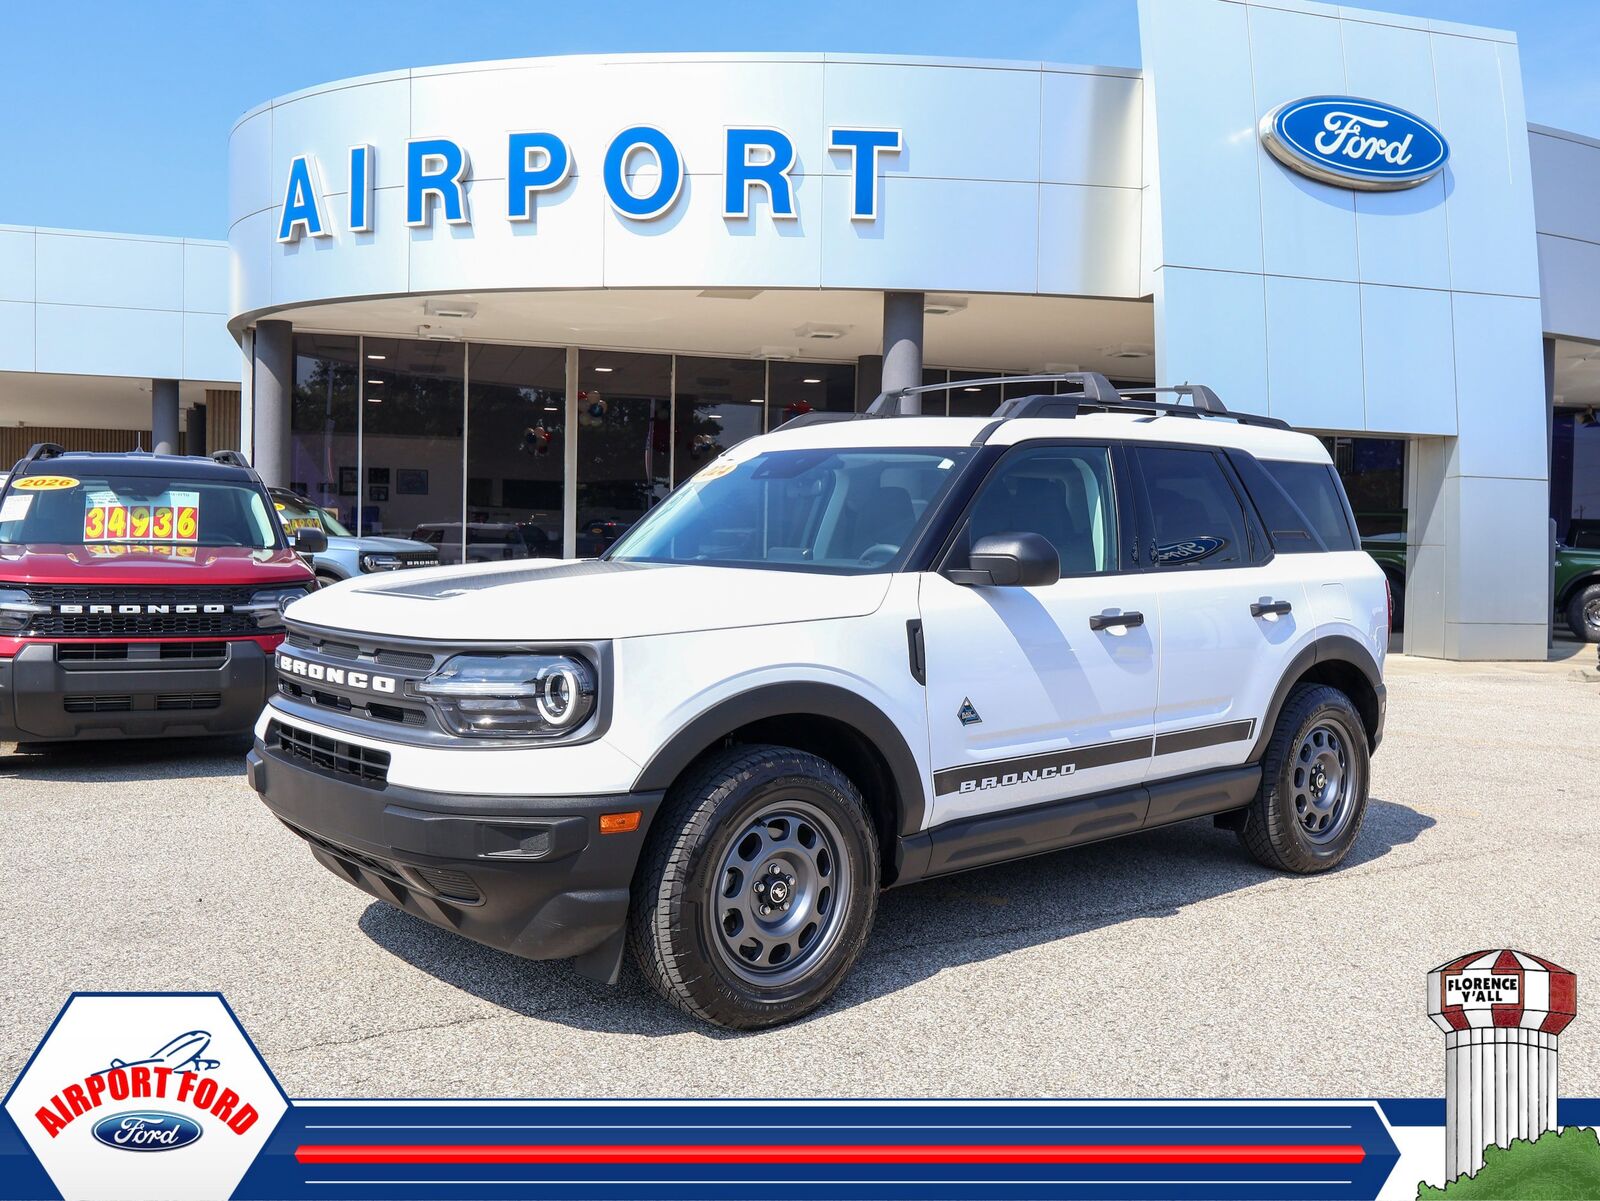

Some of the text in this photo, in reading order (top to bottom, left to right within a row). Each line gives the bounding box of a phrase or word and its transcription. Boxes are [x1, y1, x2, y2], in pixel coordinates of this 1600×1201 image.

[1314, 111, 1413, 166] Ford
[276, 124, 903, 244] AIRPORT
[20, 478, 73, 487] 2026
[85, 506, 197, 539] 34936
[60, 604, 225, 613] BRONCO
[280, 655, 396, 694] BRONCO
[959, 763, 1077, 794] BRONCO
